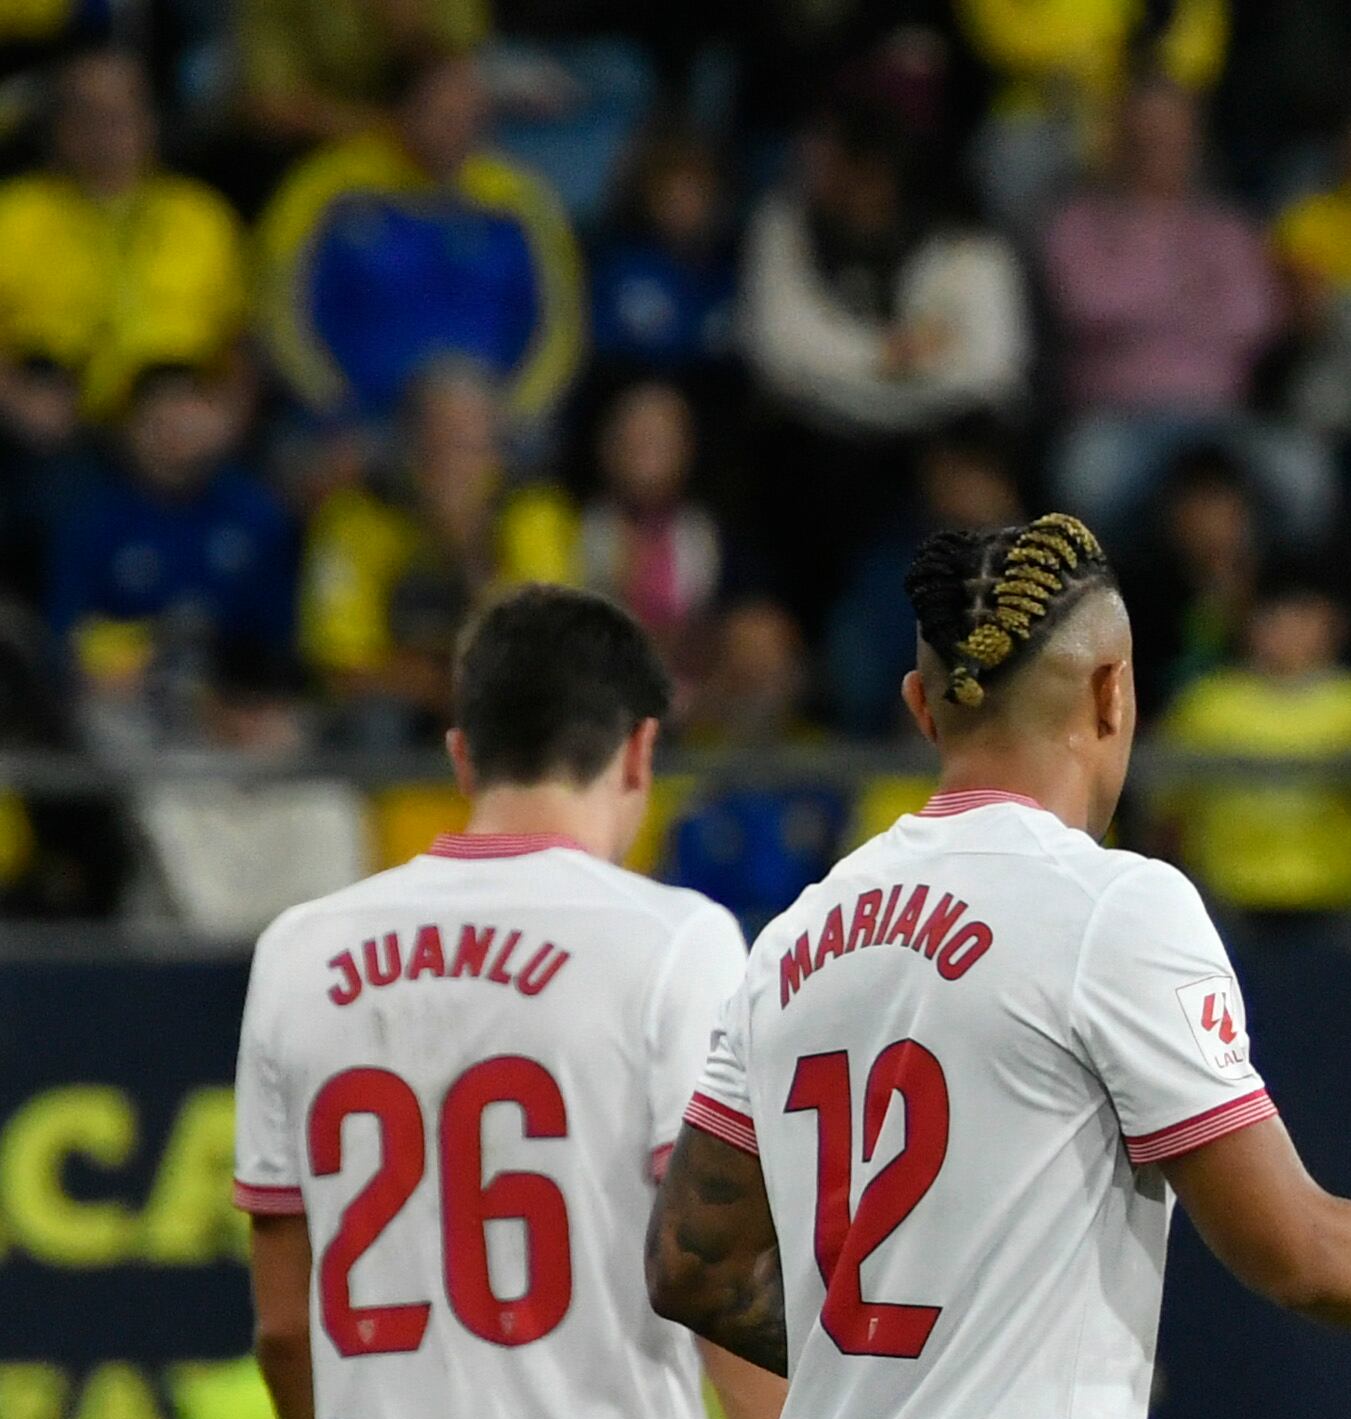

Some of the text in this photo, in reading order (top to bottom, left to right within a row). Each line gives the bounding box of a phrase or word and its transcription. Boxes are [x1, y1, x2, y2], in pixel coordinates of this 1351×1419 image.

[327, 923, 571, 1006] JUANLU
[780, 884, 994, 1010] MARIANO
[307, 1054, 572, 1358] 26
[784, 1037, 950, 1359] 12
